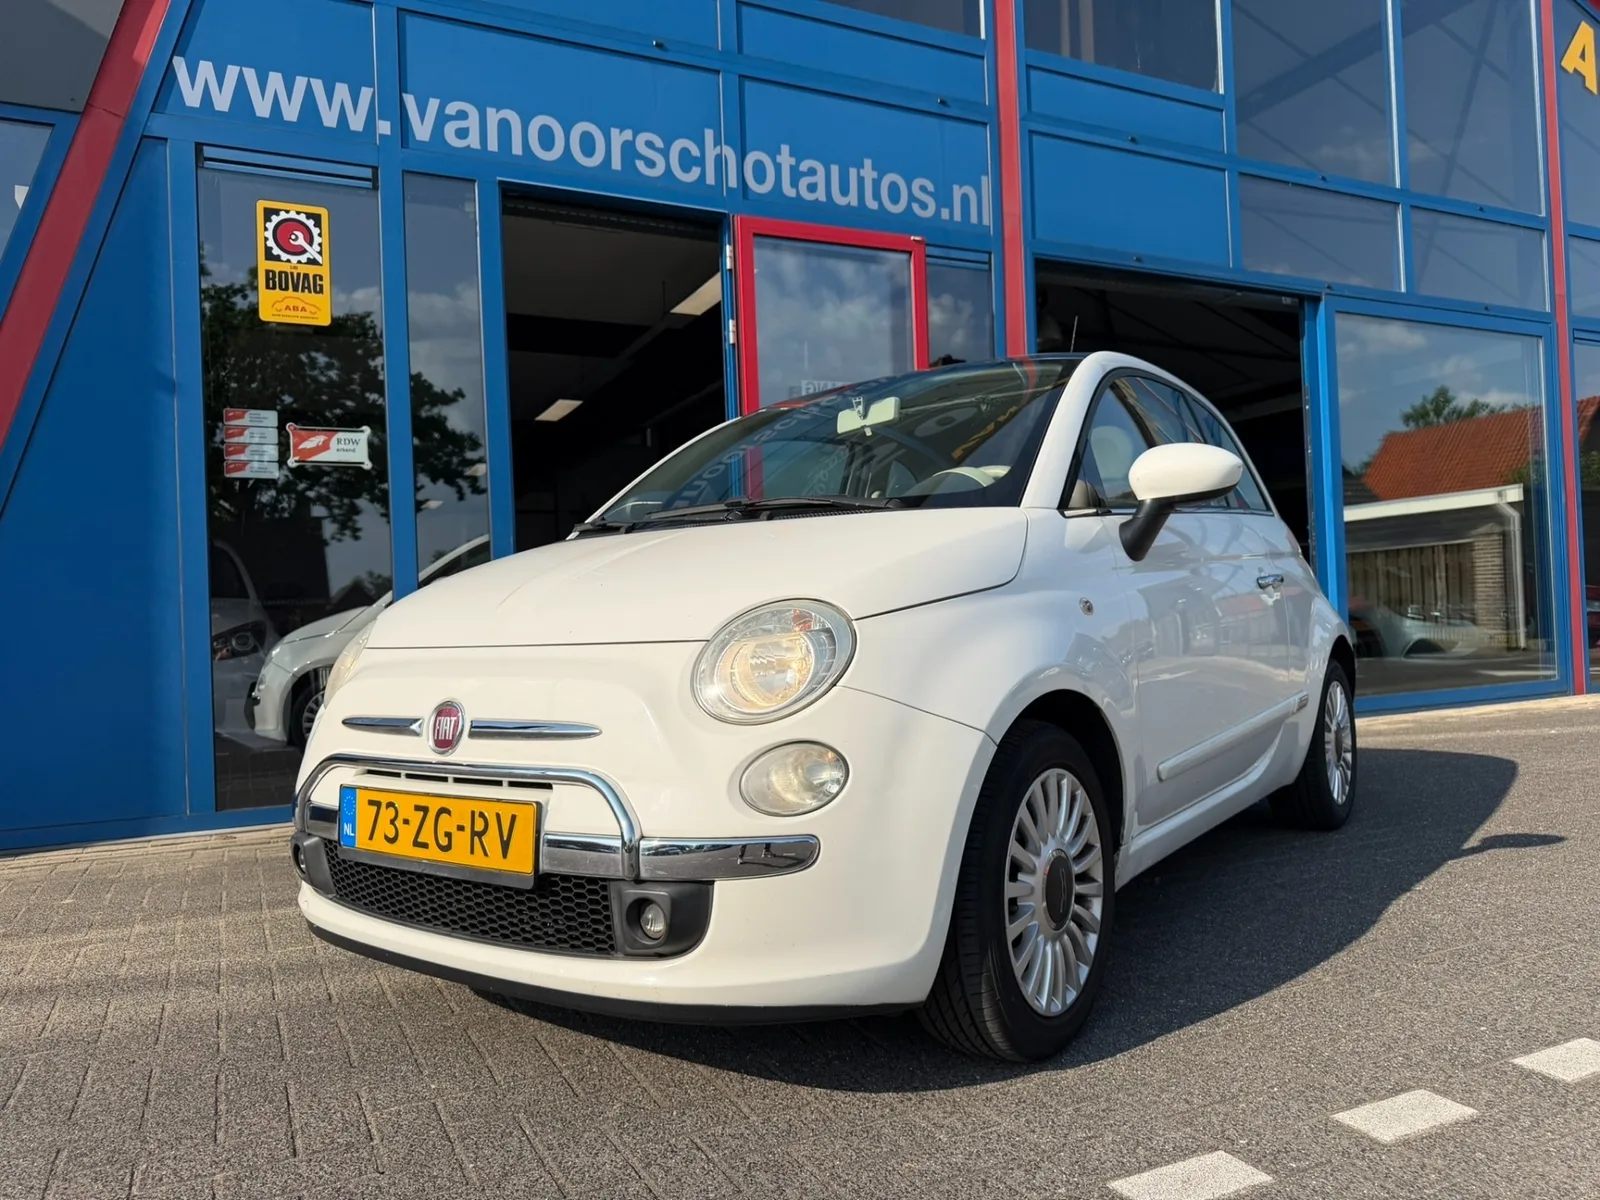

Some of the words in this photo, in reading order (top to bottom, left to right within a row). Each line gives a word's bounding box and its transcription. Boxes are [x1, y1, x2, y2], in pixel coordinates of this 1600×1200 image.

[264, 268, 325, 296] BOVAG
[284, 304, 307, 313] ABA
[336, 437, 361, 447] RDW
[434, 716, 458, 740] FIAT
[343, 822, 355, 837] NL
[367, 799, 517, 860] 73-ZG-RV
